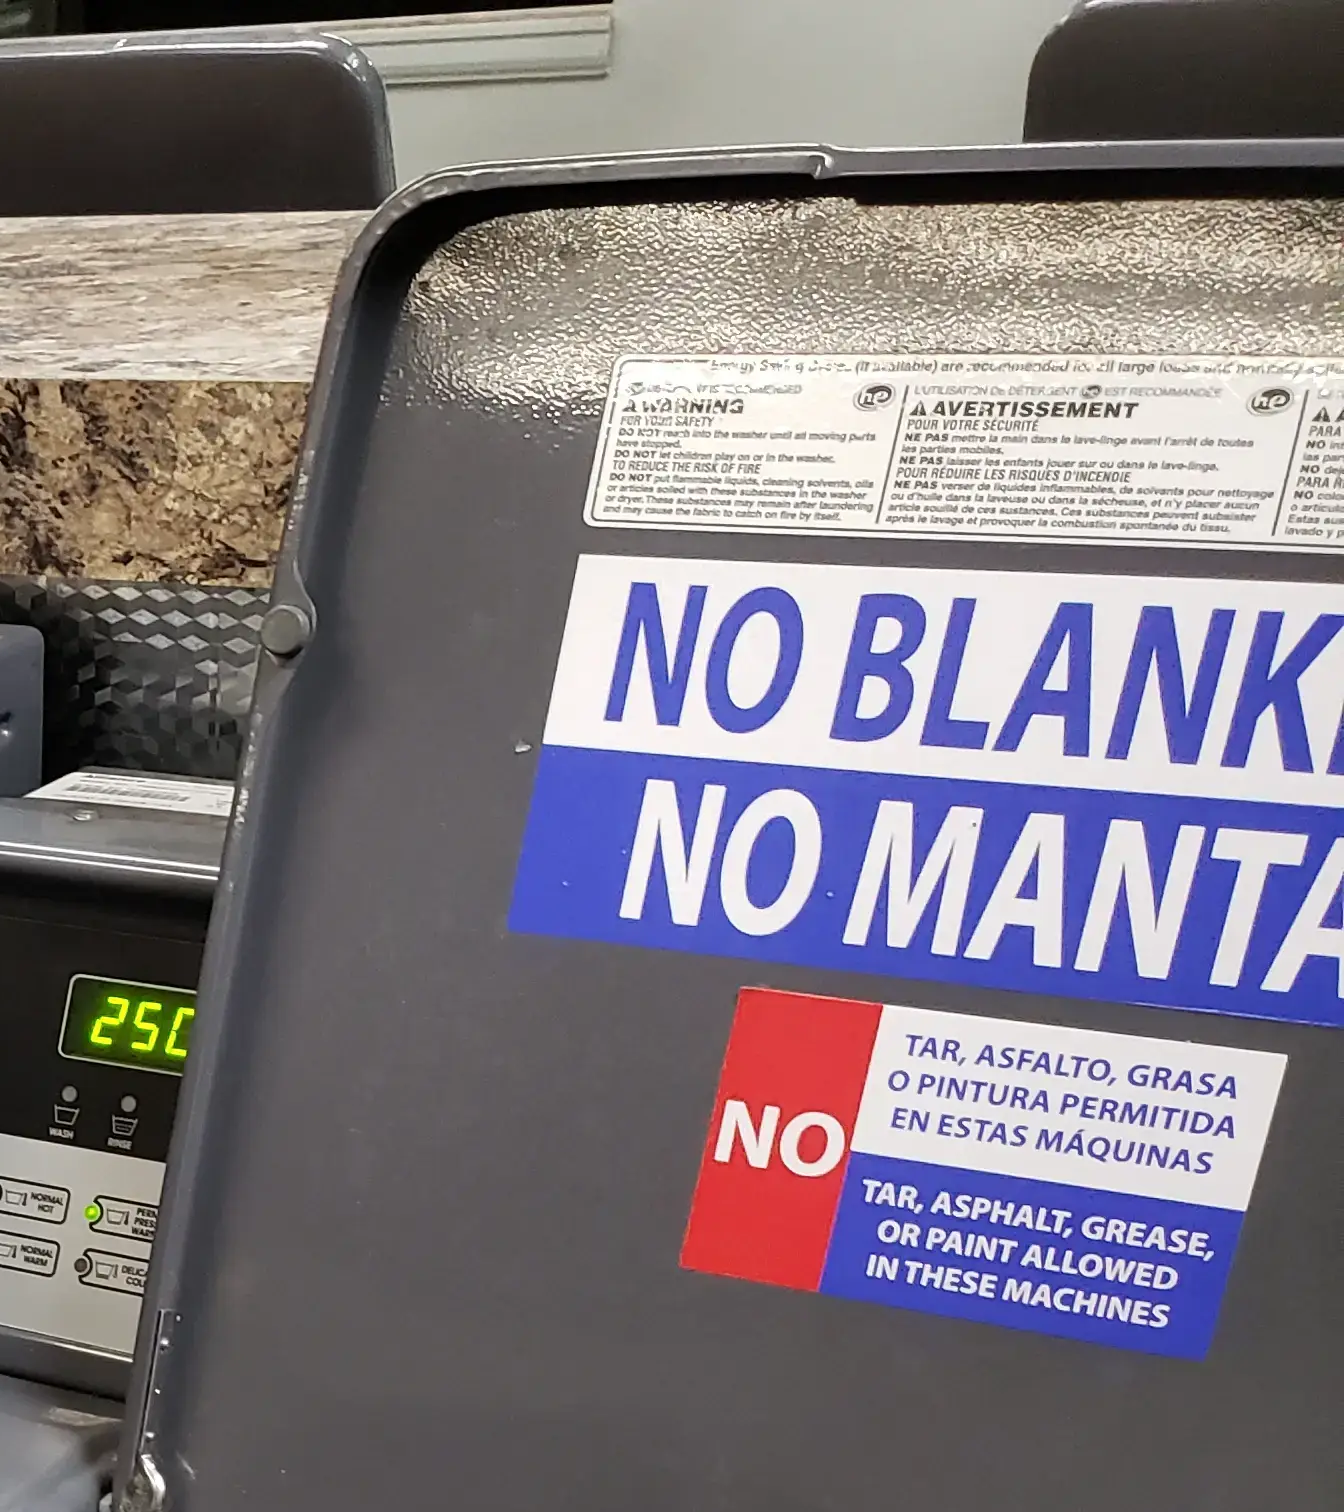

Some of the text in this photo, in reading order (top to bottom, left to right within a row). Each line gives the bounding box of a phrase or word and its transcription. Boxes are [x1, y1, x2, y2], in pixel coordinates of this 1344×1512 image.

[643, 398, 743, 414] WARNING
[934, 401, 1138, 418] AVERTISSEMENT
[907, 415, 938, 430] POUR
[943, 416, 979, 431] VOTRE
[924, 433, 949, 442] PAS
[1306, 441, 1326, 449] NO
[633, 450, 657, 459] NOT
[919, 456, 943, 466] PAS
[613, 460, 762, 475] TO REDUCE THE RISK OF FIRE
[1300, 465, 1320, 473] NO
[628, 473, 652, 482] NOT
[914, 480, 938, 490] PAS
[1297, 476, 1329, 488] PARA
[1294, 491, 1313, 499] NO
[603, 582, 1344, 776] NO BLANK
[618, 778, 821, 936] NO
[906, 1034, 1237, 1099] TAR, ASFALTO, GRASA
[887, 1070, 1236, 1139] O PINTURA PERMITIDA
[49, 1127, 74, 1139] WASH
[714, 1100, 845, 1177] NO
[890, 1108, 1213, 1175] EN ESTAS MÁQUINAS
[31, 1192, 63, 1206] NORMAL
[863, 1179, 1214, 1262] TAR, ASPHALT, GREASE,
[21, 1244, 53, 1258] NORMAL
[877, 1220, 1179, 1293] OR PAINT ALLOWED
[866, 1255, 1169, 1330] IN THESE MACHINES
